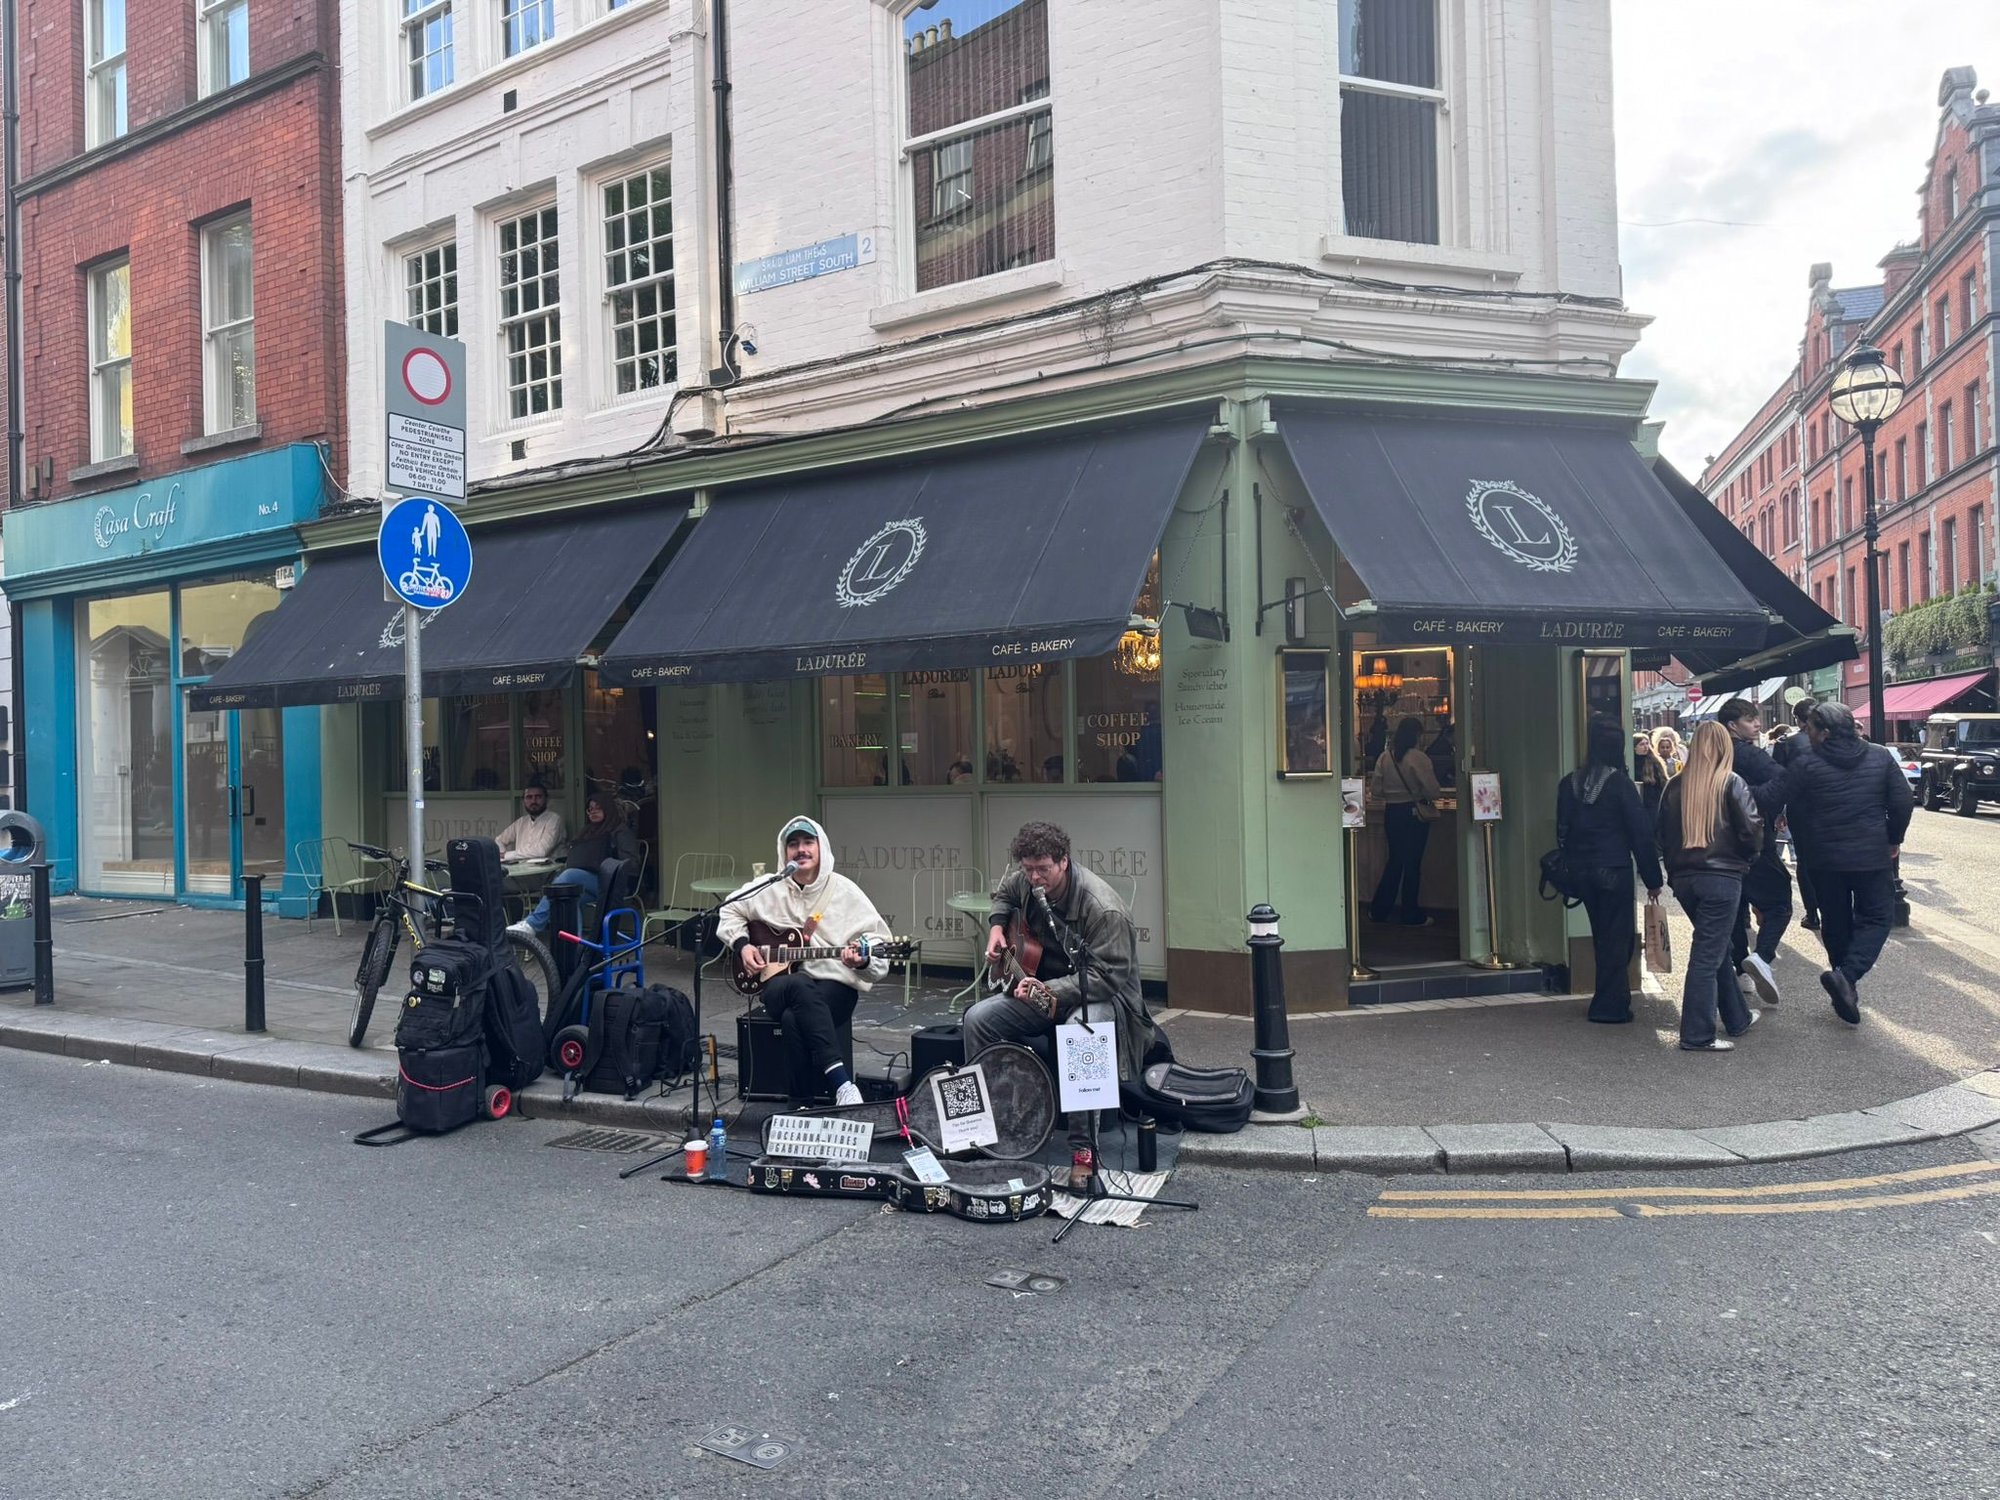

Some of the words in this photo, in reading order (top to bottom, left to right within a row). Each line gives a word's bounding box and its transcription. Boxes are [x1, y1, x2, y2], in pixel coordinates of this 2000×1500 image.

[862, 237, 872, 254] 2
[739, 273, 776, 290] WILLIAM
[780, 262, 815, 280] STREET
[819, 252, 853, 270] SOUTH
[401, 426, 453, 442] PEDESTRIANISED
[418, 436, 436, 445] ZONE
[411, 452, 430, 461] ENTRY
[432, 456, 455, 466] EXCEPT
[391, 462, 414, 471] GOODS
[415, 466, 445, 478] VEHICLES
[446, 473, 462, 481] ONLY
[417, 482, 434, 490] DAYS
[271, 501, 278, 513] 4
[94, 504, 128, 548] Casa
[133, 483, 181, 540] Craft
[1491, 505, 1551, 545] L
[856, 544, 895, 582] L
[1413, 619, 1444, 632] CAFÉ
[1455, 620, 1504, 633] BAKERY
[1540, 620, 1625, 639] LADURÉE
[1657, 625, 1684, 637] CAFÉ
[1693, 626, 1735, 637] BAKERY
[992, 640, 1021, 656] CAFÉ
[1031, 638, 1076, 653] BAKERY
[796, 652, 866, 671] LADURÉE
[517, 673, 545, 684] BAKERY
[658, 665, 692, 677] BAKERY
[1087, 712, 1151, 727] COFFEE
[526, 736, 562, 749] COFFEE
[830, 733, 882, 748] BAKERY
[1096, 731, 1141, 747] SHOP
[531, 751, 557, 763] SHOP
[840, 844, 962, 870] LADURÉE
[958, 1092, 964, 1100] R
[773, 1118, 811, 1129] FOLLOW
[823, 1120, 835, 1129] MY
[841, 1122, 866, 1133] BAND
